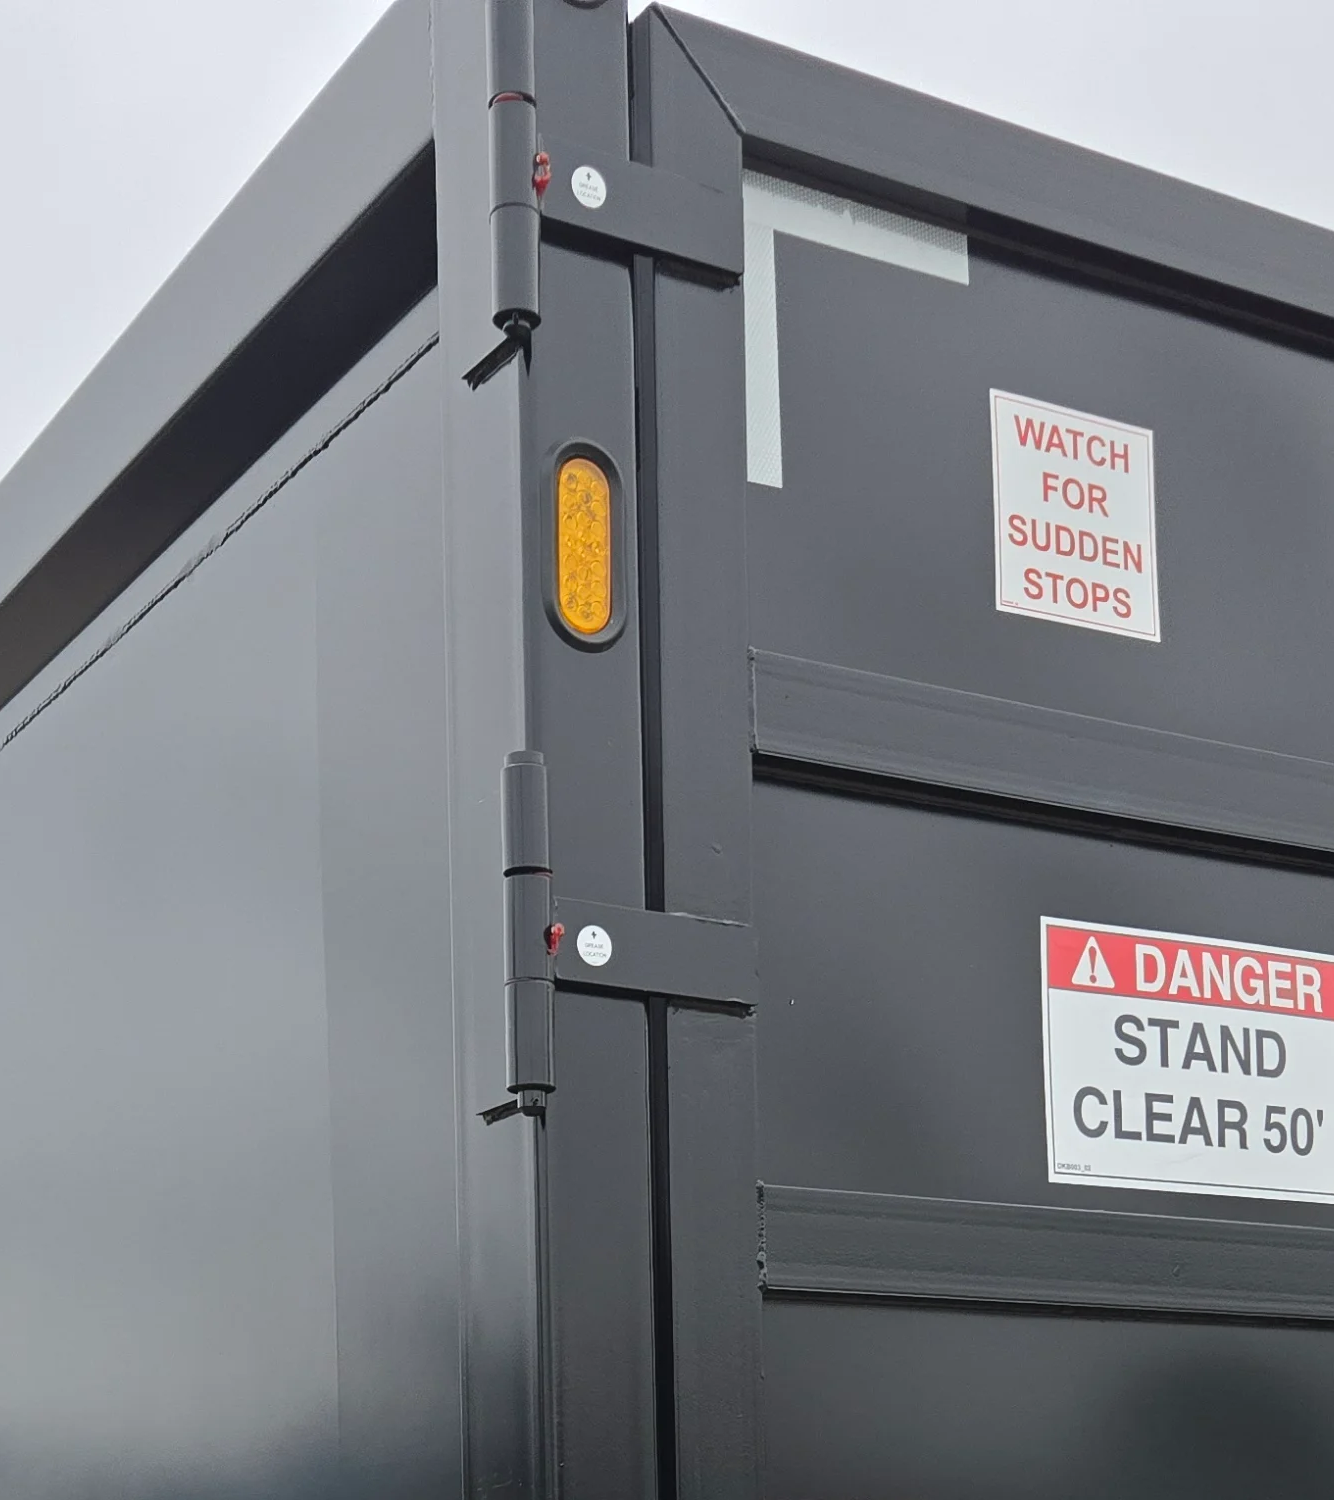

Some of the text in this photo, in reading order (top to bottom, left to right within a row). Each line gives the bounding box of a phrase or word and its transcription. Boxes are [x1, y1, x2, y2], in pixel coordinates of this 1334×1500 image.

[1014, 415, 1129, 473] WATCH
[1043, 472, 1109, 517] FOR
[1008, 514, 1143, 573] SUDDEN
[1024, 568, 1132, 619] STOPS
[1135, 944, 1323, 1013] DANGER
[1114, 1014, 1286, 1079] STAND
[1073, 1086, 1324, 1156] CLEAR 50'
